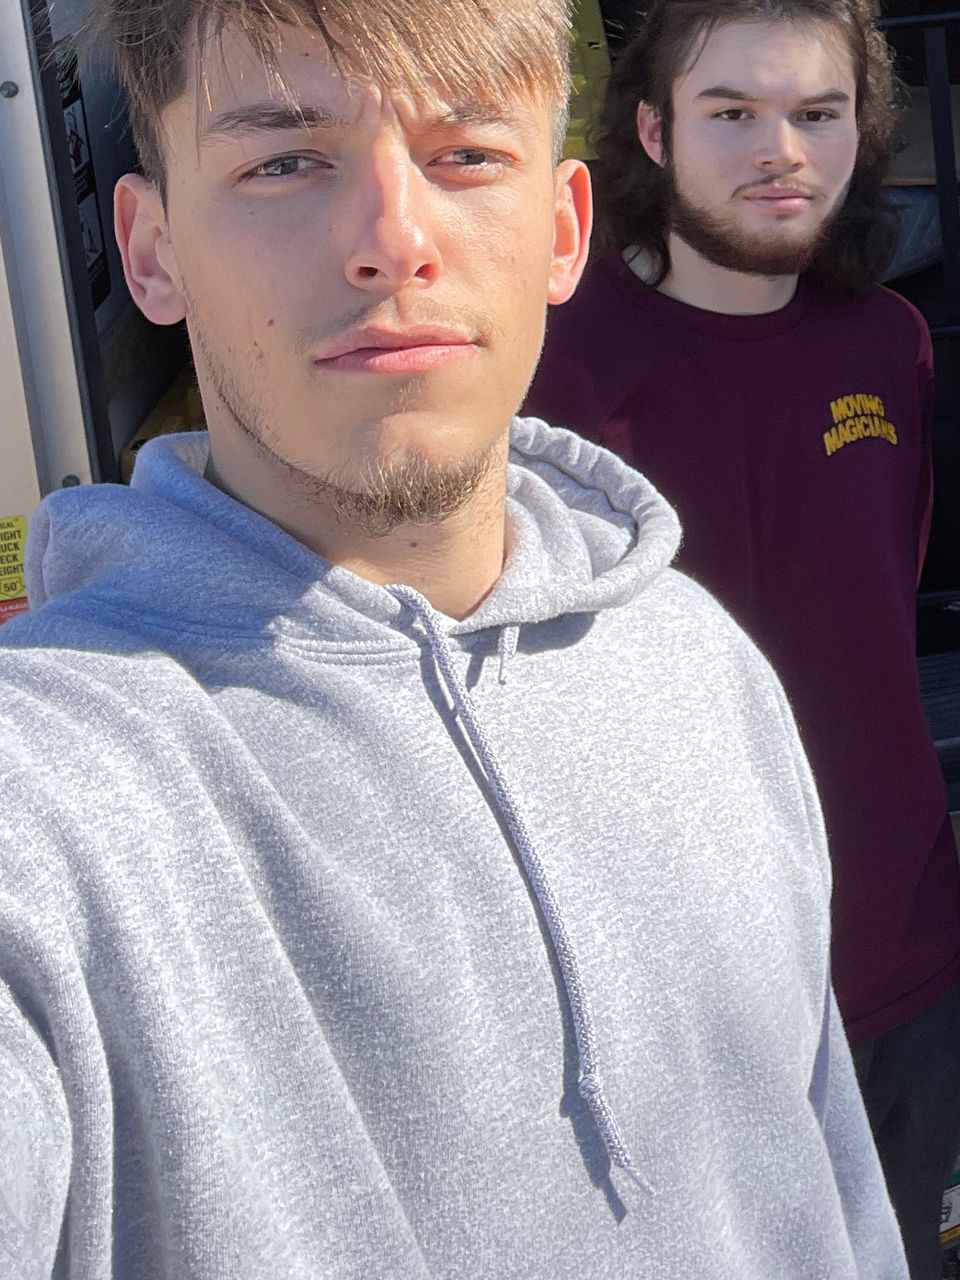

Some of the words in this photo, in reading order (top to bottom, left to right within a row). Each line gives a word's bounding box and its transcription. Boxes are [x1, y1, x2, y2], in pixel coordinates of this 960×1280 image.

[829, 392, 885, 424] MOVING
[822, 415, 898, 457] MAGICIANS
[0, 541, 20, 553] UCK
